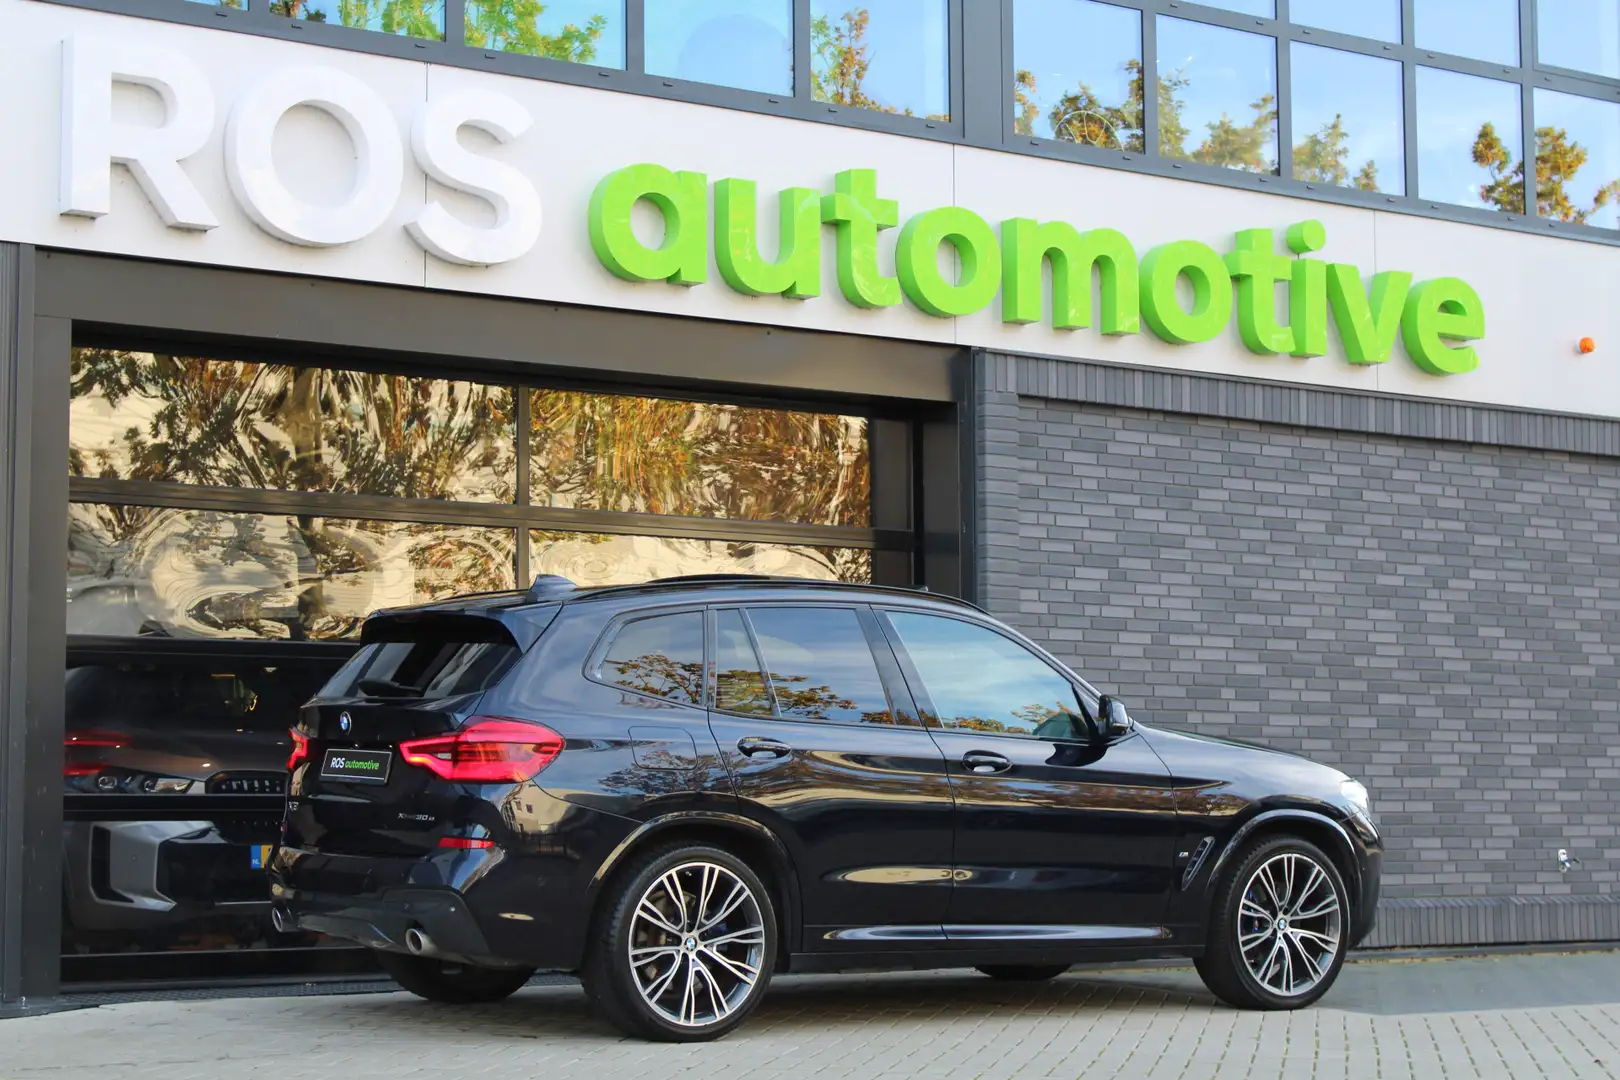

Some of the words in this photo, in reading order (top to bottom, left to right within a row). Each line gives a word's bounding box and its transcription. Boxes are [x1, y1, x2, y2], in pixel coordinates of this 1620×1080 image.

[60, 34, 543, 267] ROS
[588, 163, 1485, 376] automotive
[330, 757, 345, 769] ROS
[345, 760, 380, 770] automotive
